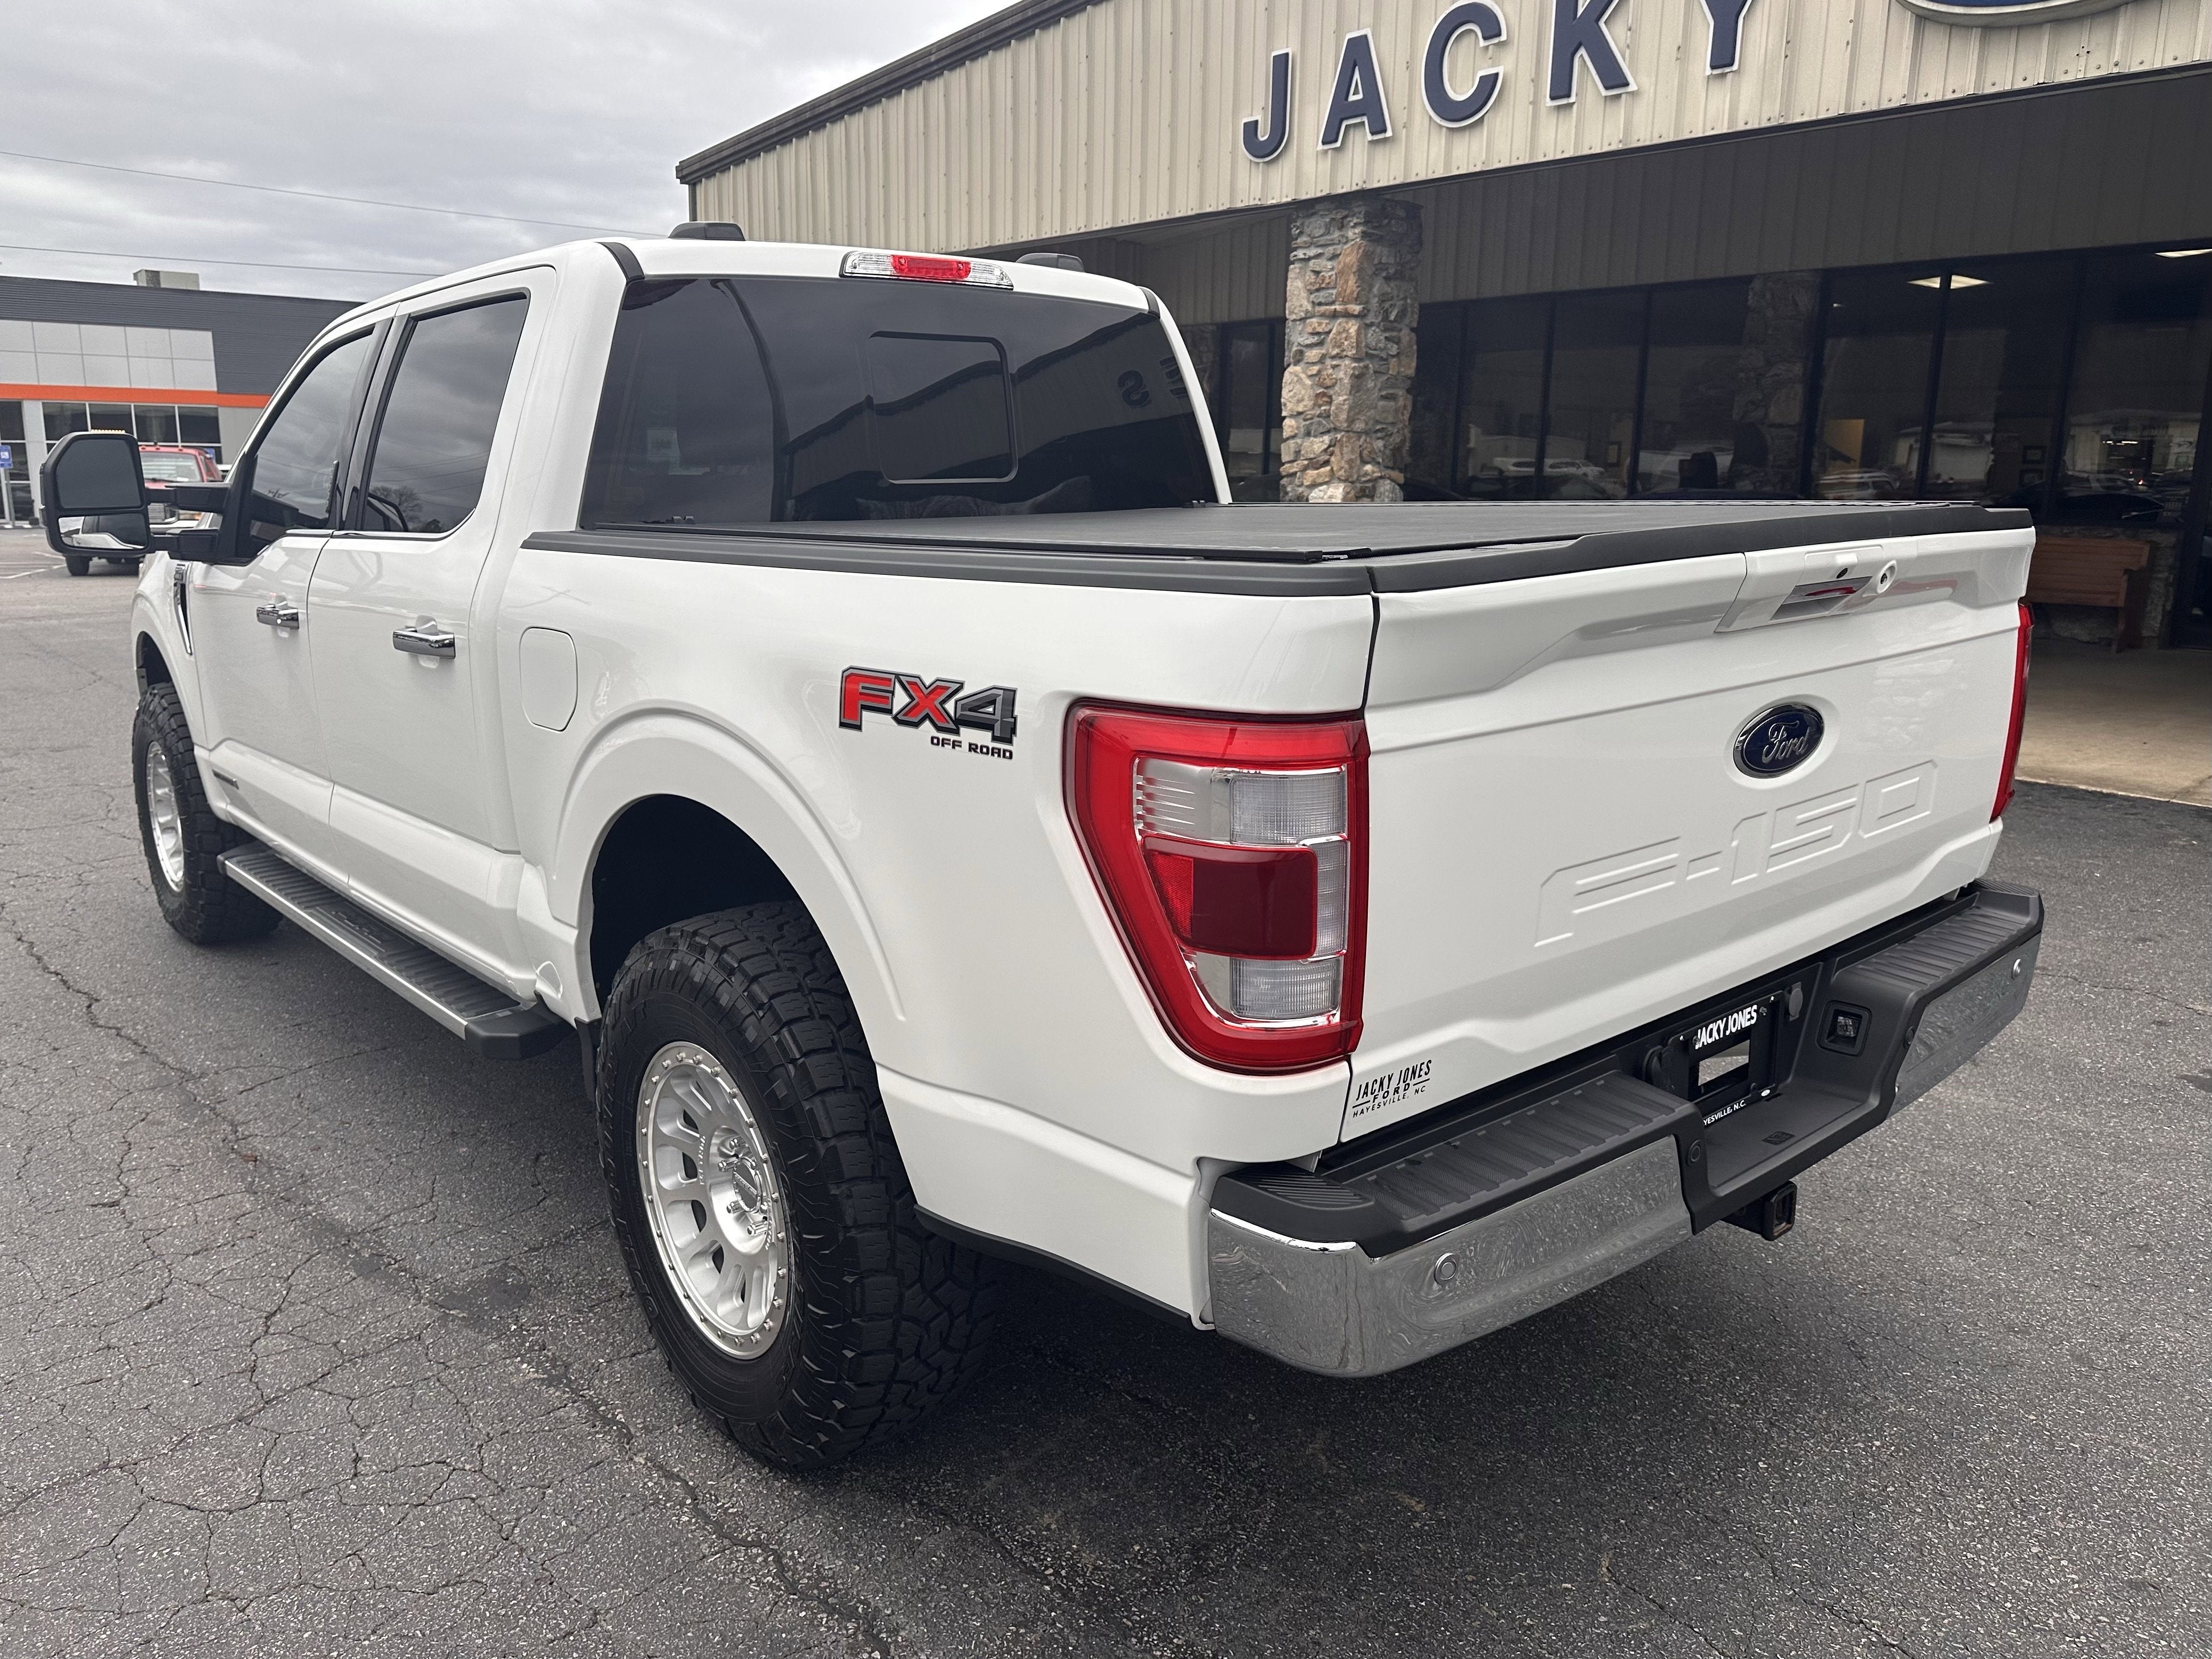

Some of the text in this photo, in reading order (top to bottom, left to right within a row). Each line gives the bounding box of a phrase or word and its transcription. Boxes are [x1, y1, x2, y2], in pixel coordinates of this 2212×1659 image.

[839, 665, 1018, 746] FX4
[930, 735, 1013, 761] OFF ROAD
[1762, 720, 1810, 763] Ford
[1534, 759, 1937, 947] F-150
[1695, 1004, 1757, 1050] JACKY JONES
[1356, 1059, 1432, 1101] JACKY JONES
[1372, 1082, 1410, 1104] FORD
[1414, 1085, 1426, 1096] NC
[1703, 1106, 1733, 1126] YESVILLE,
